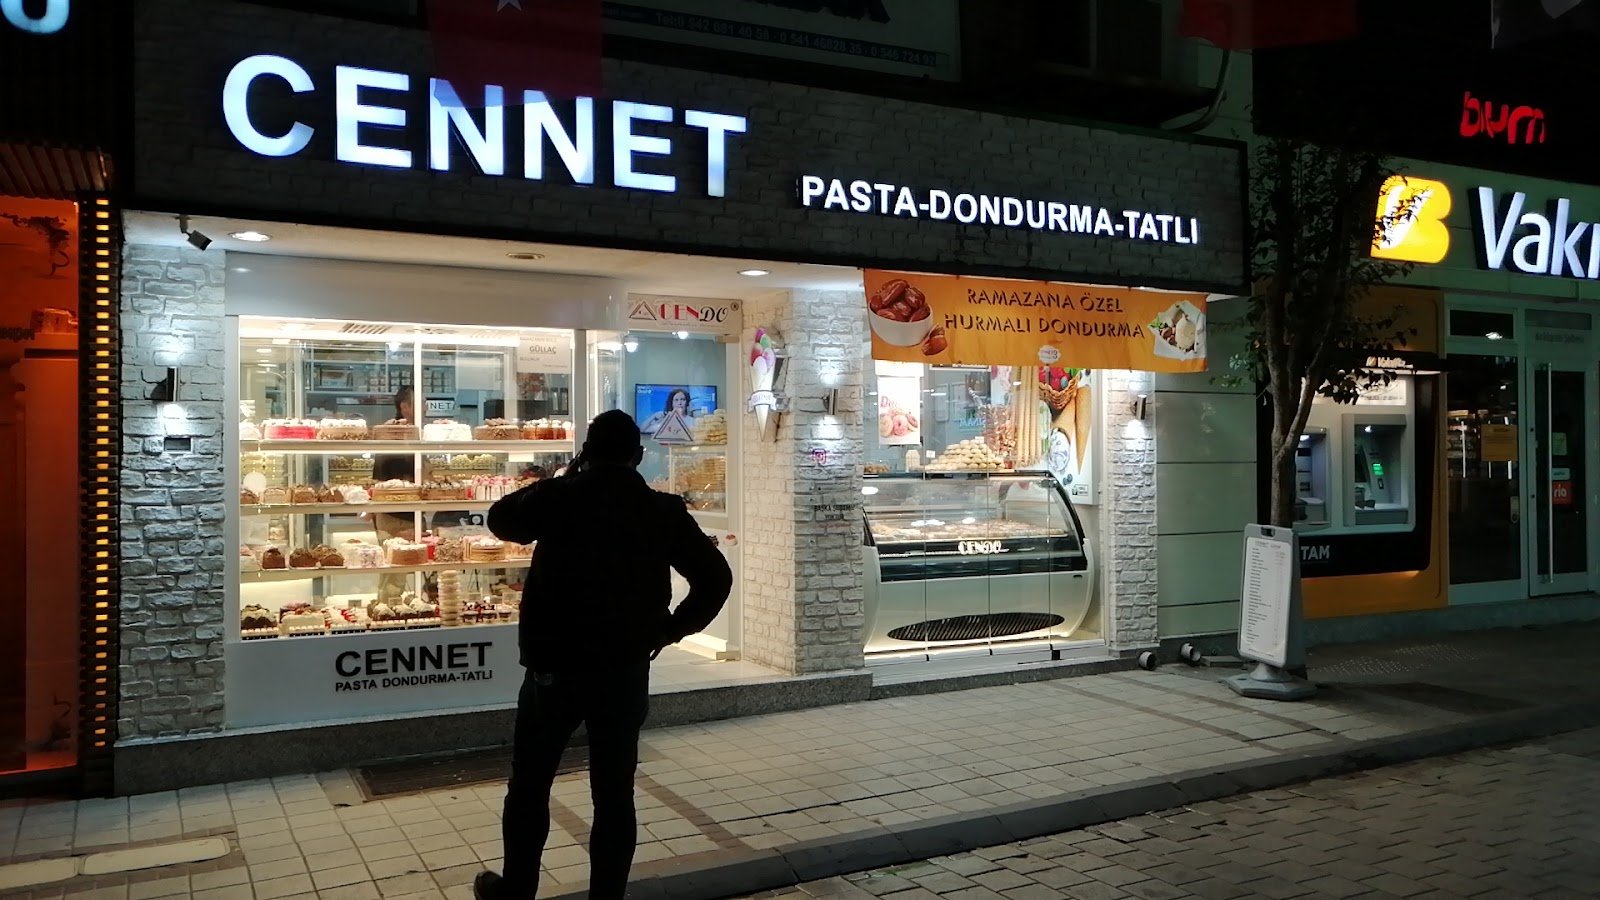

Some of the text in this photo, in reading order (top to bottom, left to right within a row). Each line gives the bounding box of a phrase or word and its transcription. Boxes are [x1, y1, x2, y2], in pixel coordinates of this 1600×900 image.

[222, 54, 747, 198] CENNET
[801, 174, 1199, 246] PASTA-DONDURMA-TATLI
[967, 288, 1124, 313] RAMAZANA ÖZEL
[945, 313, 1146, 339] HURMALI DONDURMA
[529, 344, 557, 354] GÜLLAÇ
[1299, 544, 1331, 561] TAM
[335, 641, 493, 678] CENNET
[335, 669, 493, 693] PASTA DONDURMA-TATLI
